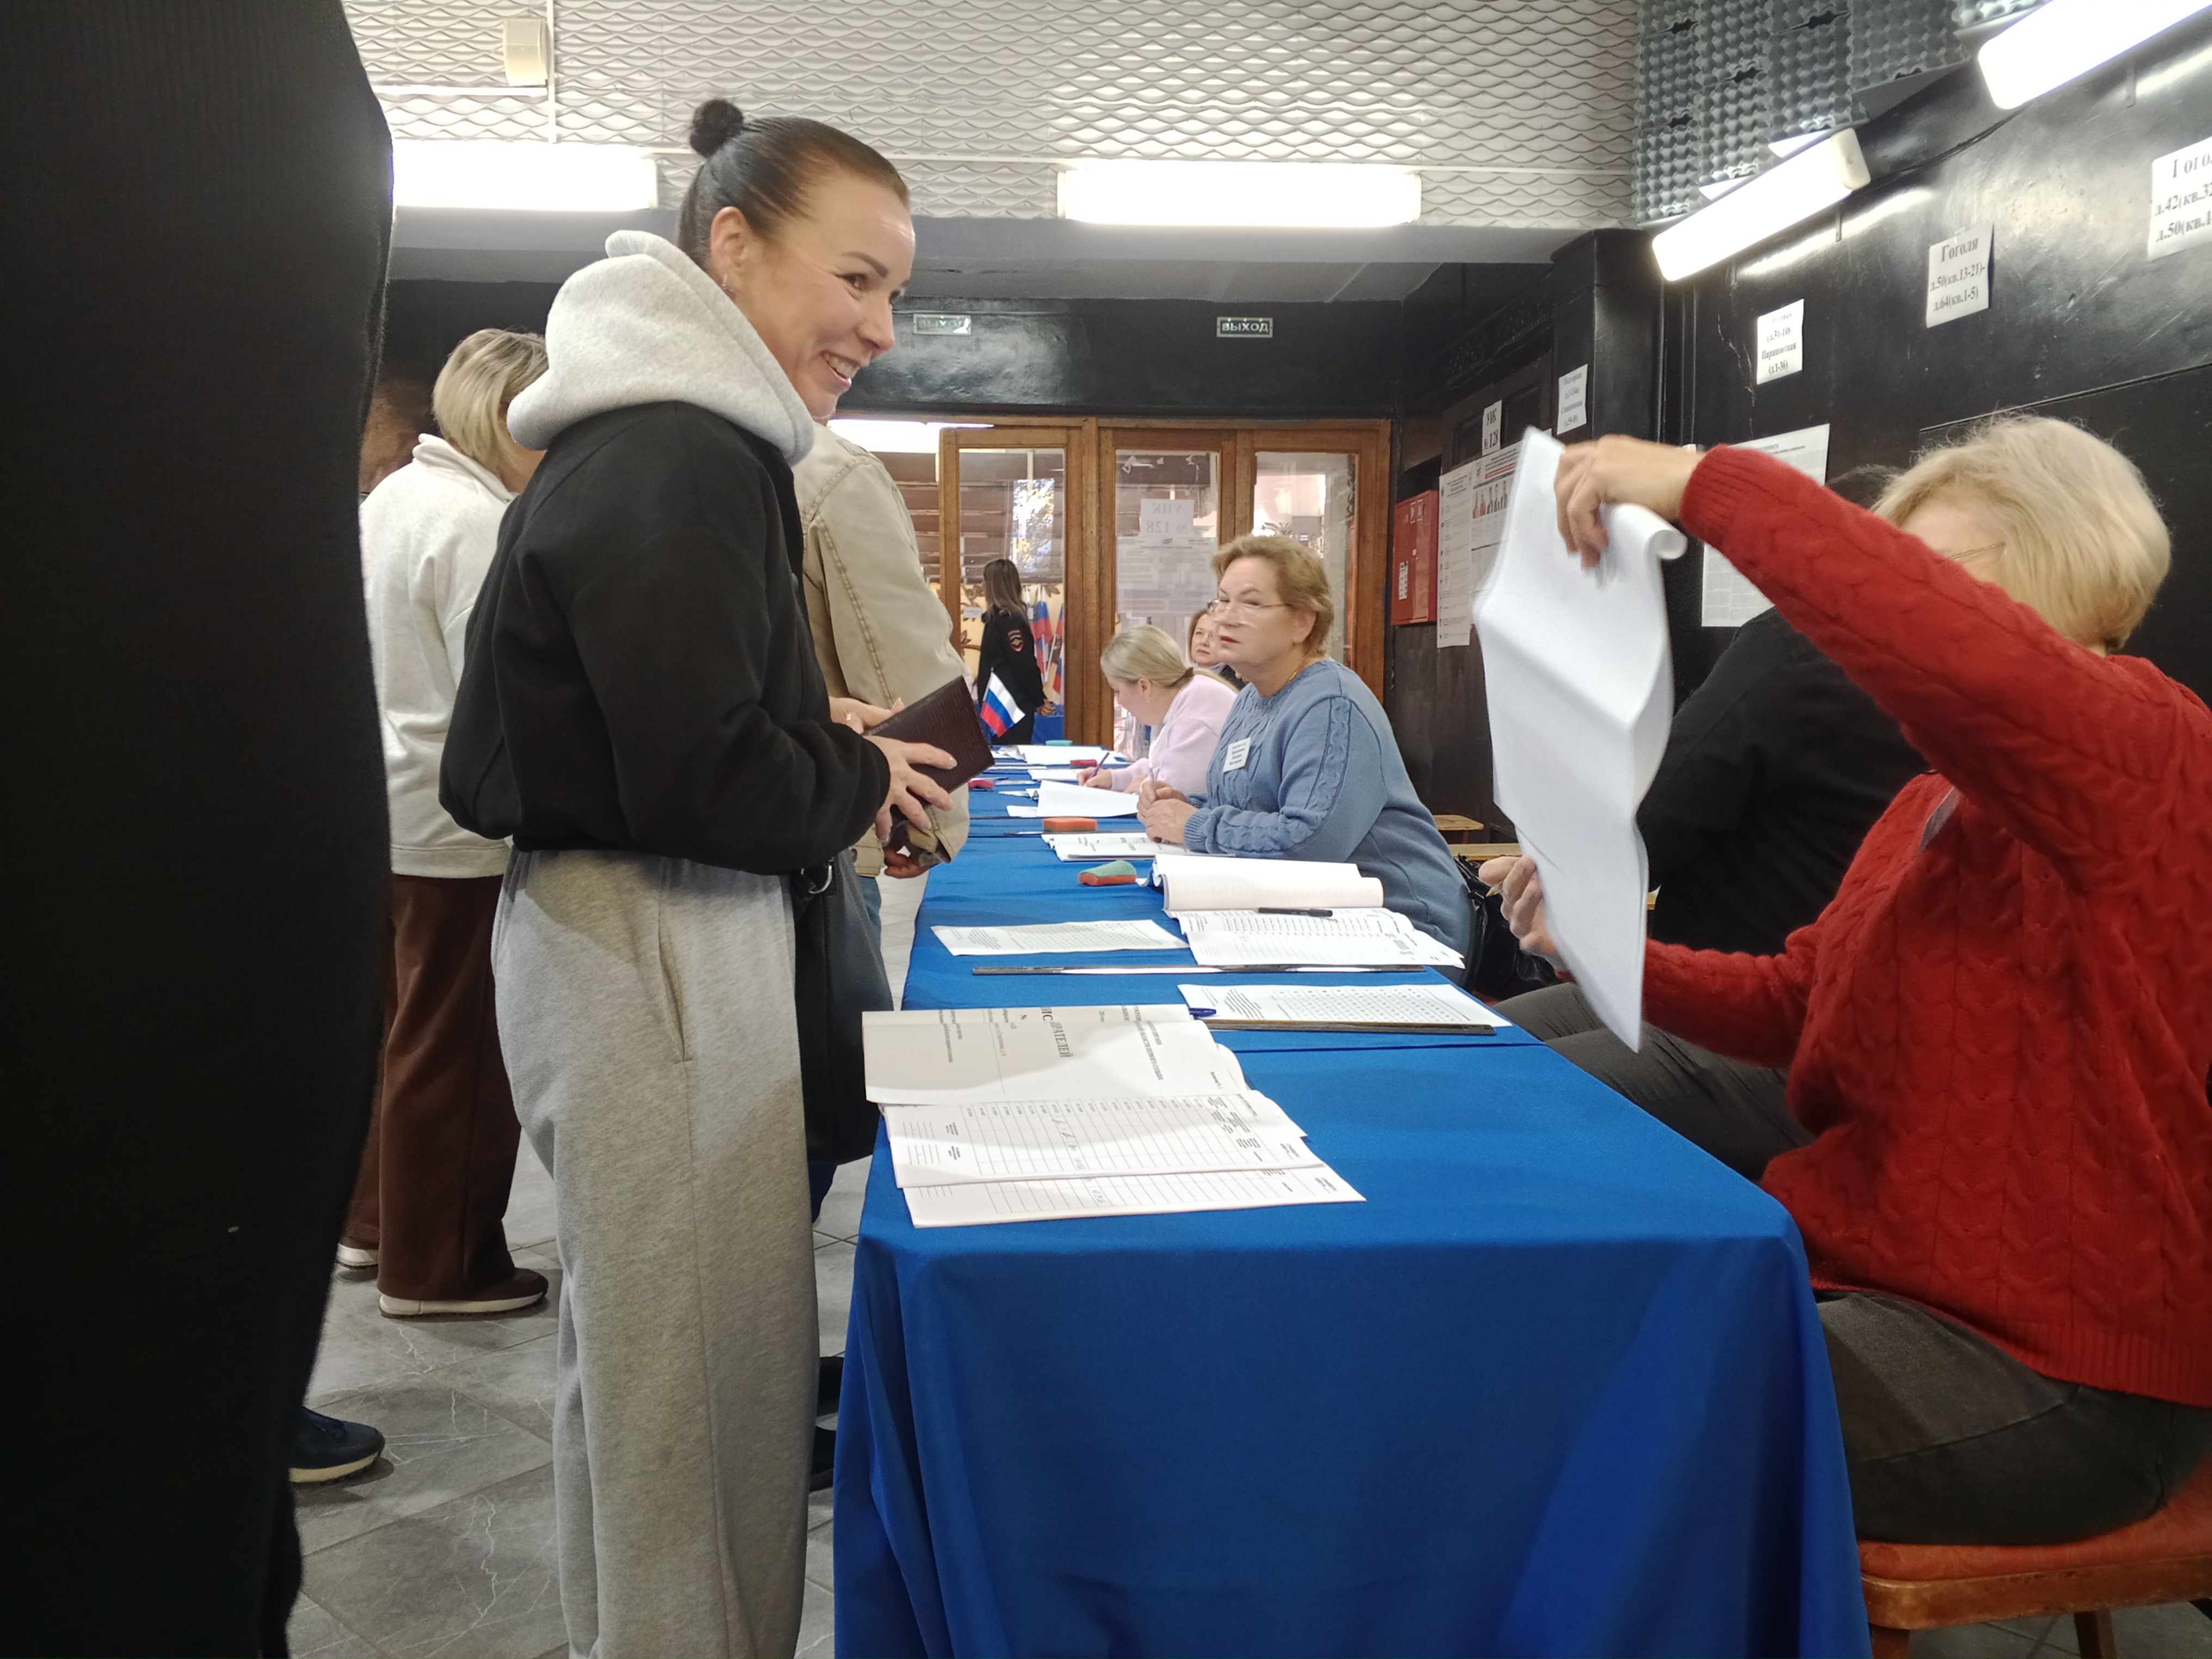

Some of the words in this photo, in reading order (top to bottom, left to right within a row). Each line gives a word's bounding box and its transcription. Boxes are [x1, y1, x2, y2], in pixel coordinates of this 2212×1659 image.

[2172, 153, 2212, 179] Гого
[2156, 210, 2212, 243] д.50(кв.1
[1940, 238, 1978, 262] Гоголя
[1221, 323, 1269, 333] ВЫХОД
[1761, 342, 1797, 360] Парашютная
[1486, 408, 1497, 425] УИК
[1490, 429, 1498, 448] 128
